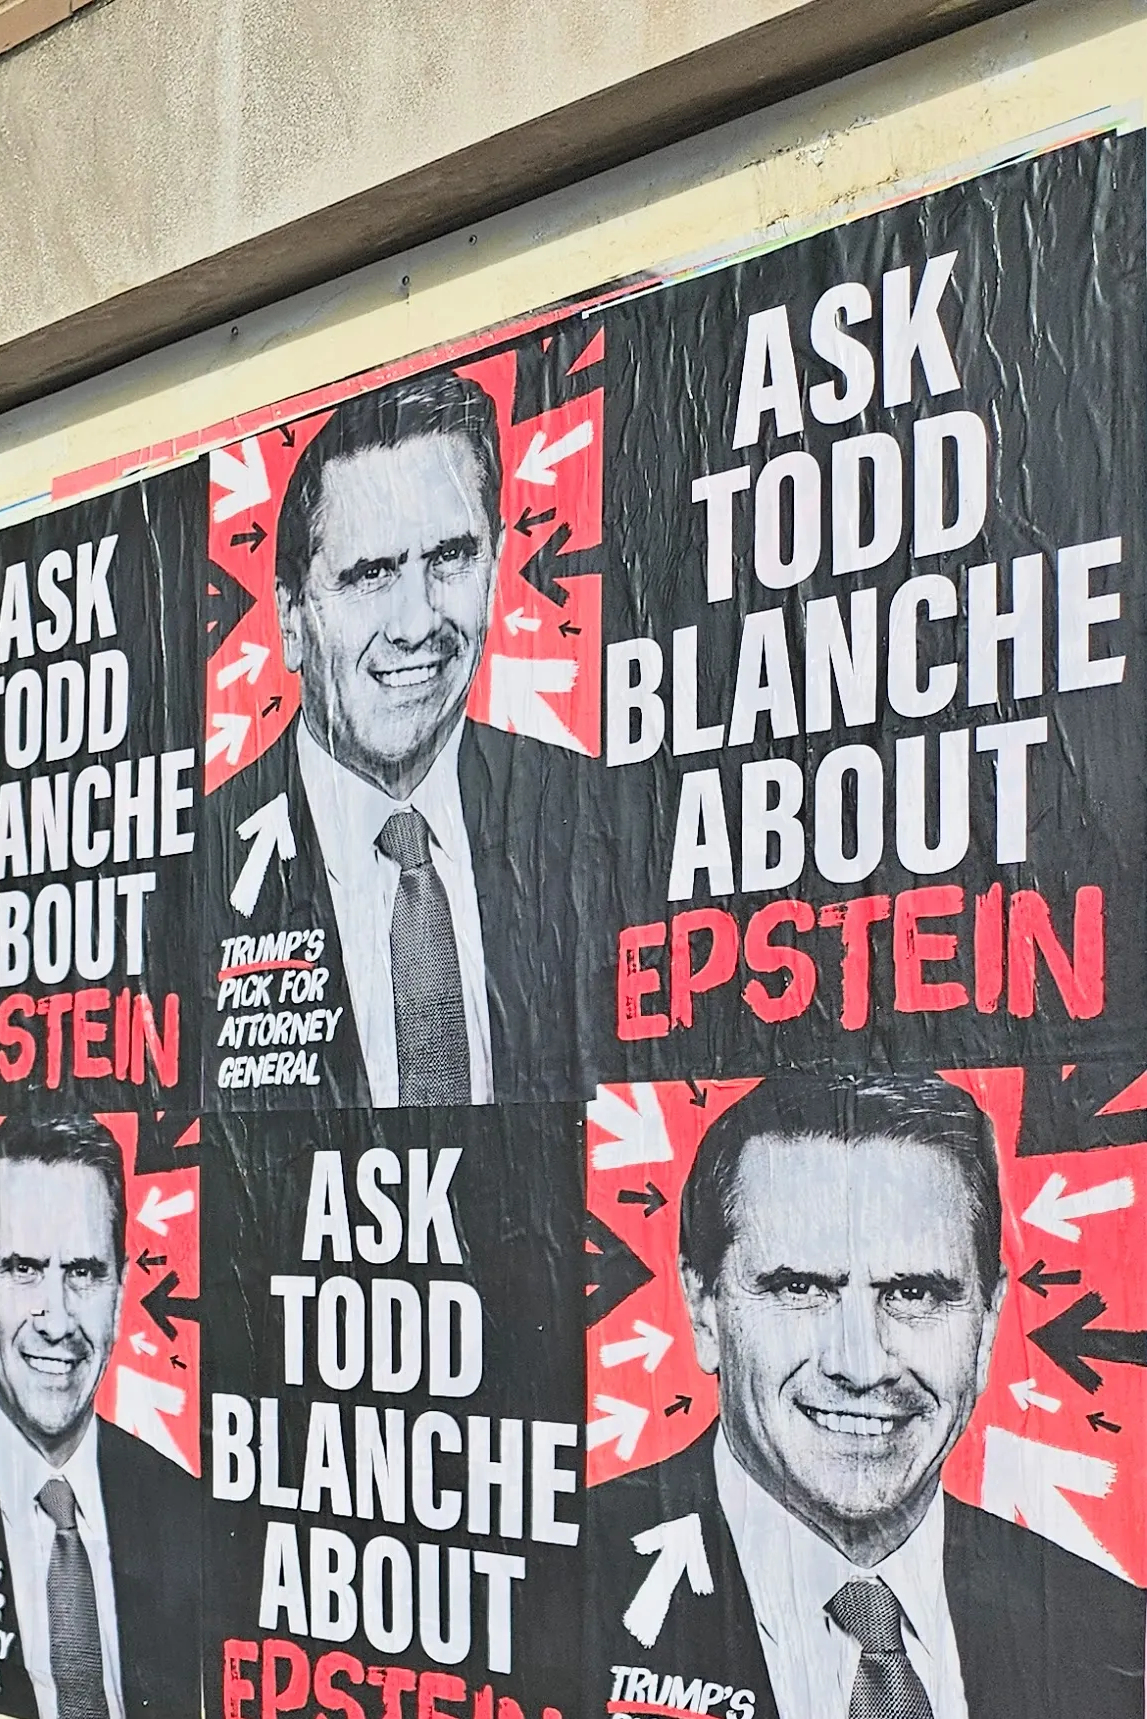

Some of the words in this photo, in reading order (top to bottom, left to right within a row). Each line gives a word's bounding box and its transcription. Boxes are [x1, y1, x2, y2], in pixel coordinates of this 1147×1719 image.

[732, 250, 962, 450] ASK
[691, 411, 989, 604] TODD
[606, 536, 1126, 768] BLANCHE
[667, 716, 1048, 902] ABOUT
[217, 974, 274, 1012] PICK
[278, 967, 329, 1004] FOR
[220, 929, 325, 972] TRUMP'S
[617, 882, 1106, 1042] EPSTEIN
[217, 1006, 344, 1050] ATTORNEY
[218, 1050, 321, 1089] GENERAL
[301, 1147, 464, 1265] ASK
[270, 1275, 483, 1397] TODD
[211, 1392, 581, 1547] BLANCHE
[258, 1520, 527, 1675] ABOUT
[610, 1665, 756, 1719] TRUMP'S
